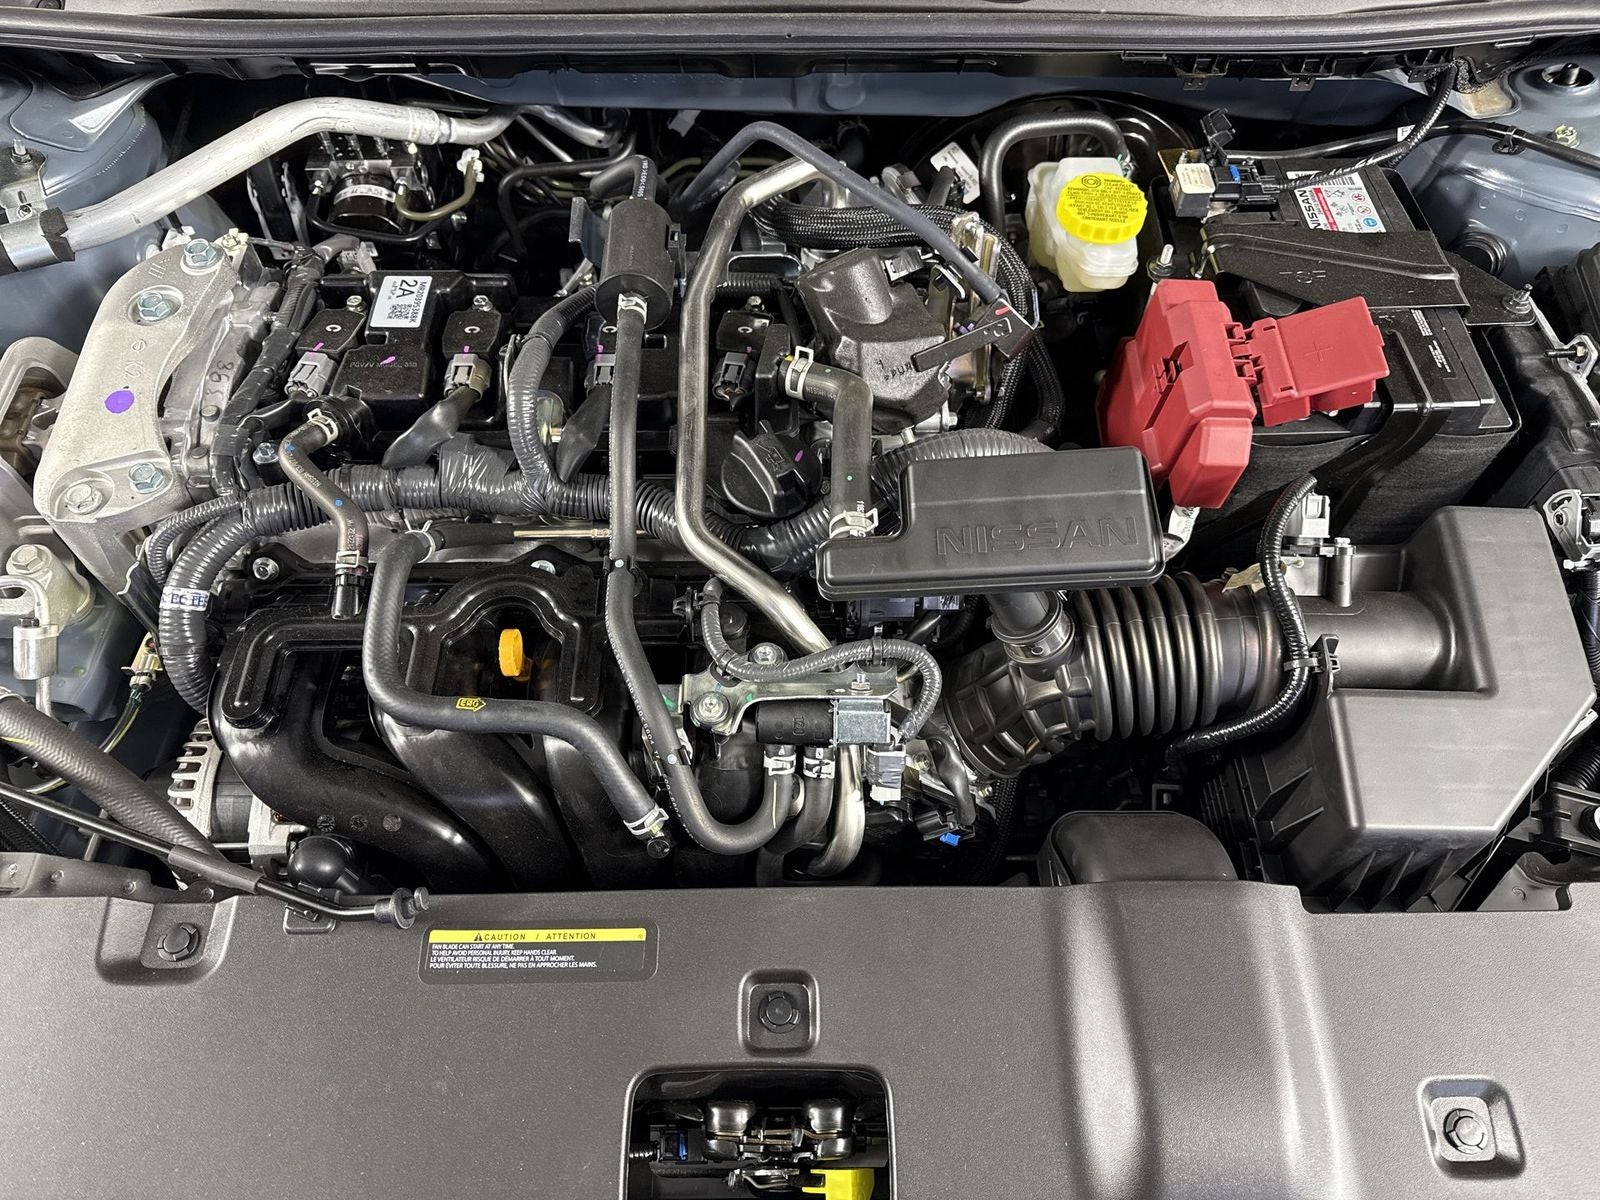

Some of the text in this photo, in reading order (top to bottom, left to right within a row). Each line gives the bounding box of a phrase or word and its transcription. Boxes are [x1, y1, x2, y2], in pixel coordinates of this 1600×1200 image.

[396, 279, 418, 299] 2A
[936, 516, 1139, 555] NISSAN
[460, 699, 480, 707] ENG
[484, 933, 526, 941] CAUTION
[546, 932, 596, 940] ATTENTION
